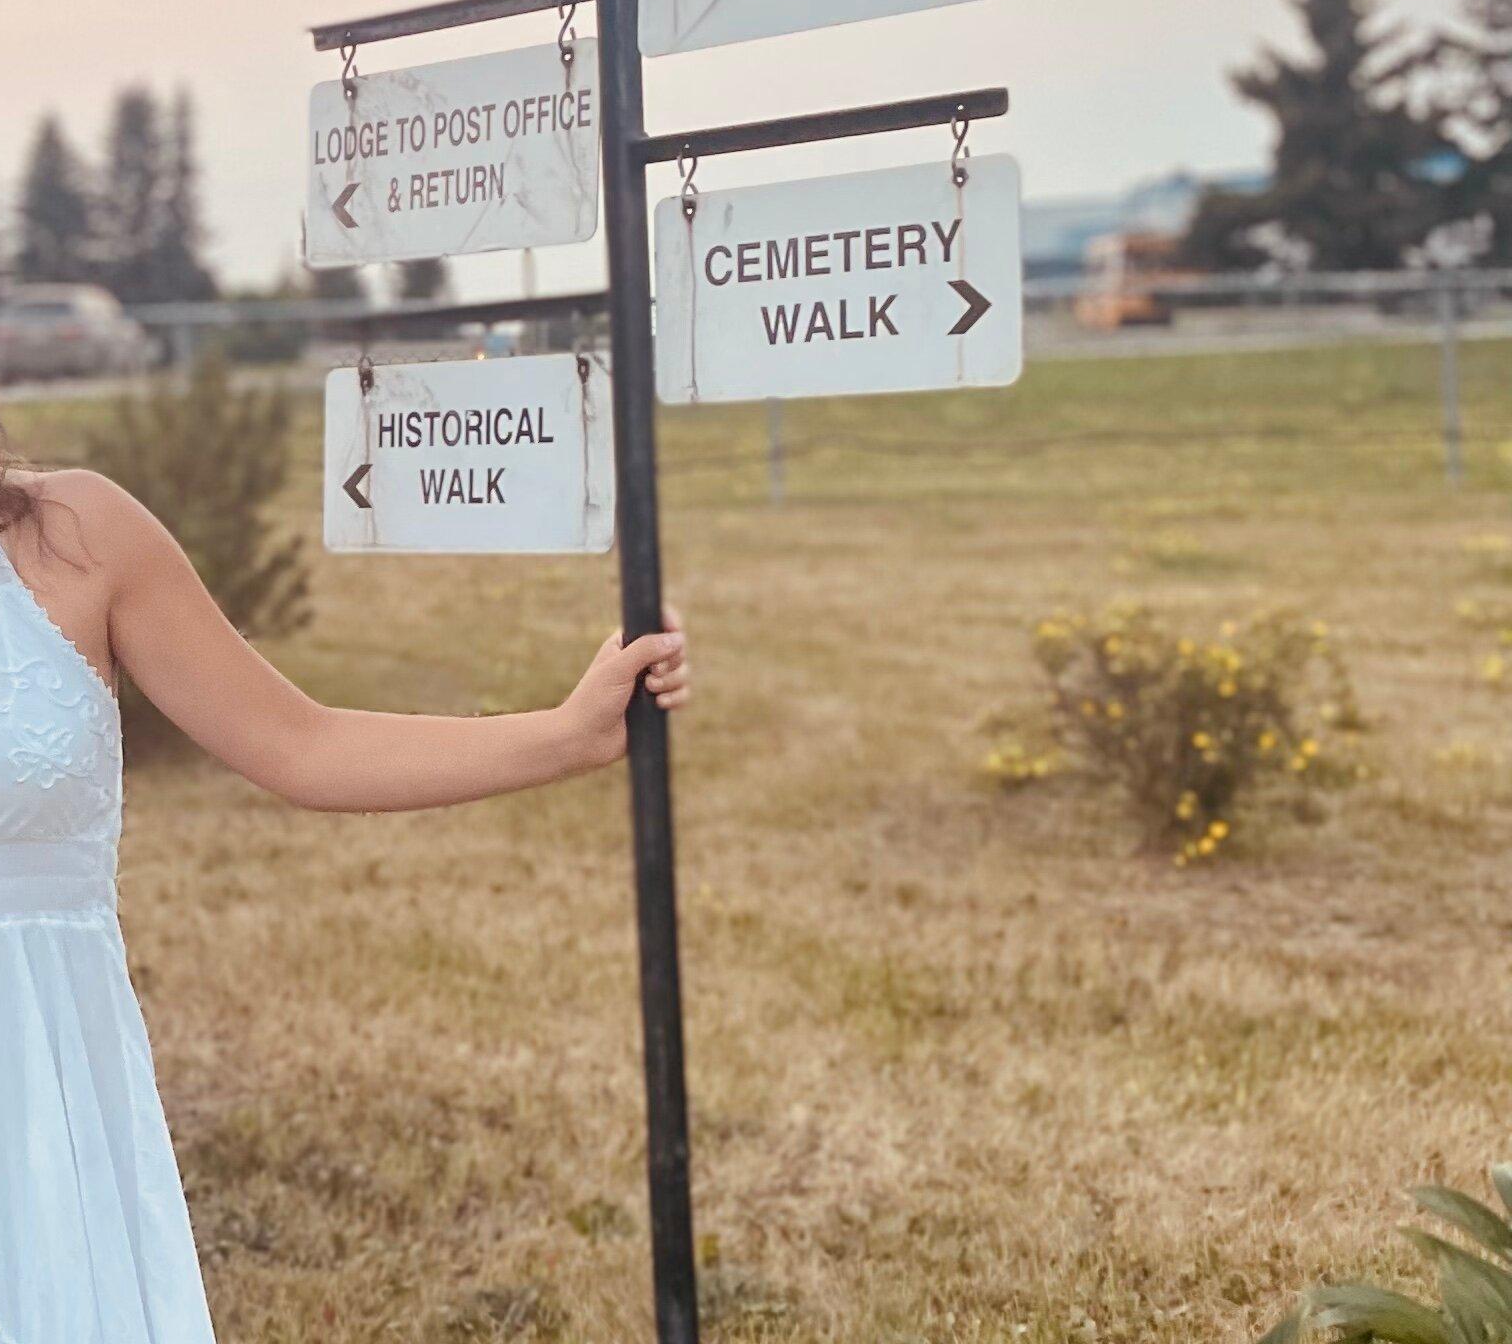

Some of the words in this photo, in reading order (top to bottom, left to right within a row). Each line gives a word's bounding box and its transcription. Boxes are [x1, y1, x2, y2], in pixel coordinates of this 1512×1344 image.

[315, 120, 388, 165] LODGE
[396, 115, 426, 153] TO
[434, 104, 496, 148] POST
[503, 89, 592, 138] OFFICE
[388, 177, 402, 212] &
[410, 162, 504, 210] RETURN
[705, 218, 963, 286] CEMETERY
[761, 294, 899, 345] WALK
[378, 407, 554, 448] HISTORICAL
[420, 467, 506, 504] WALK
